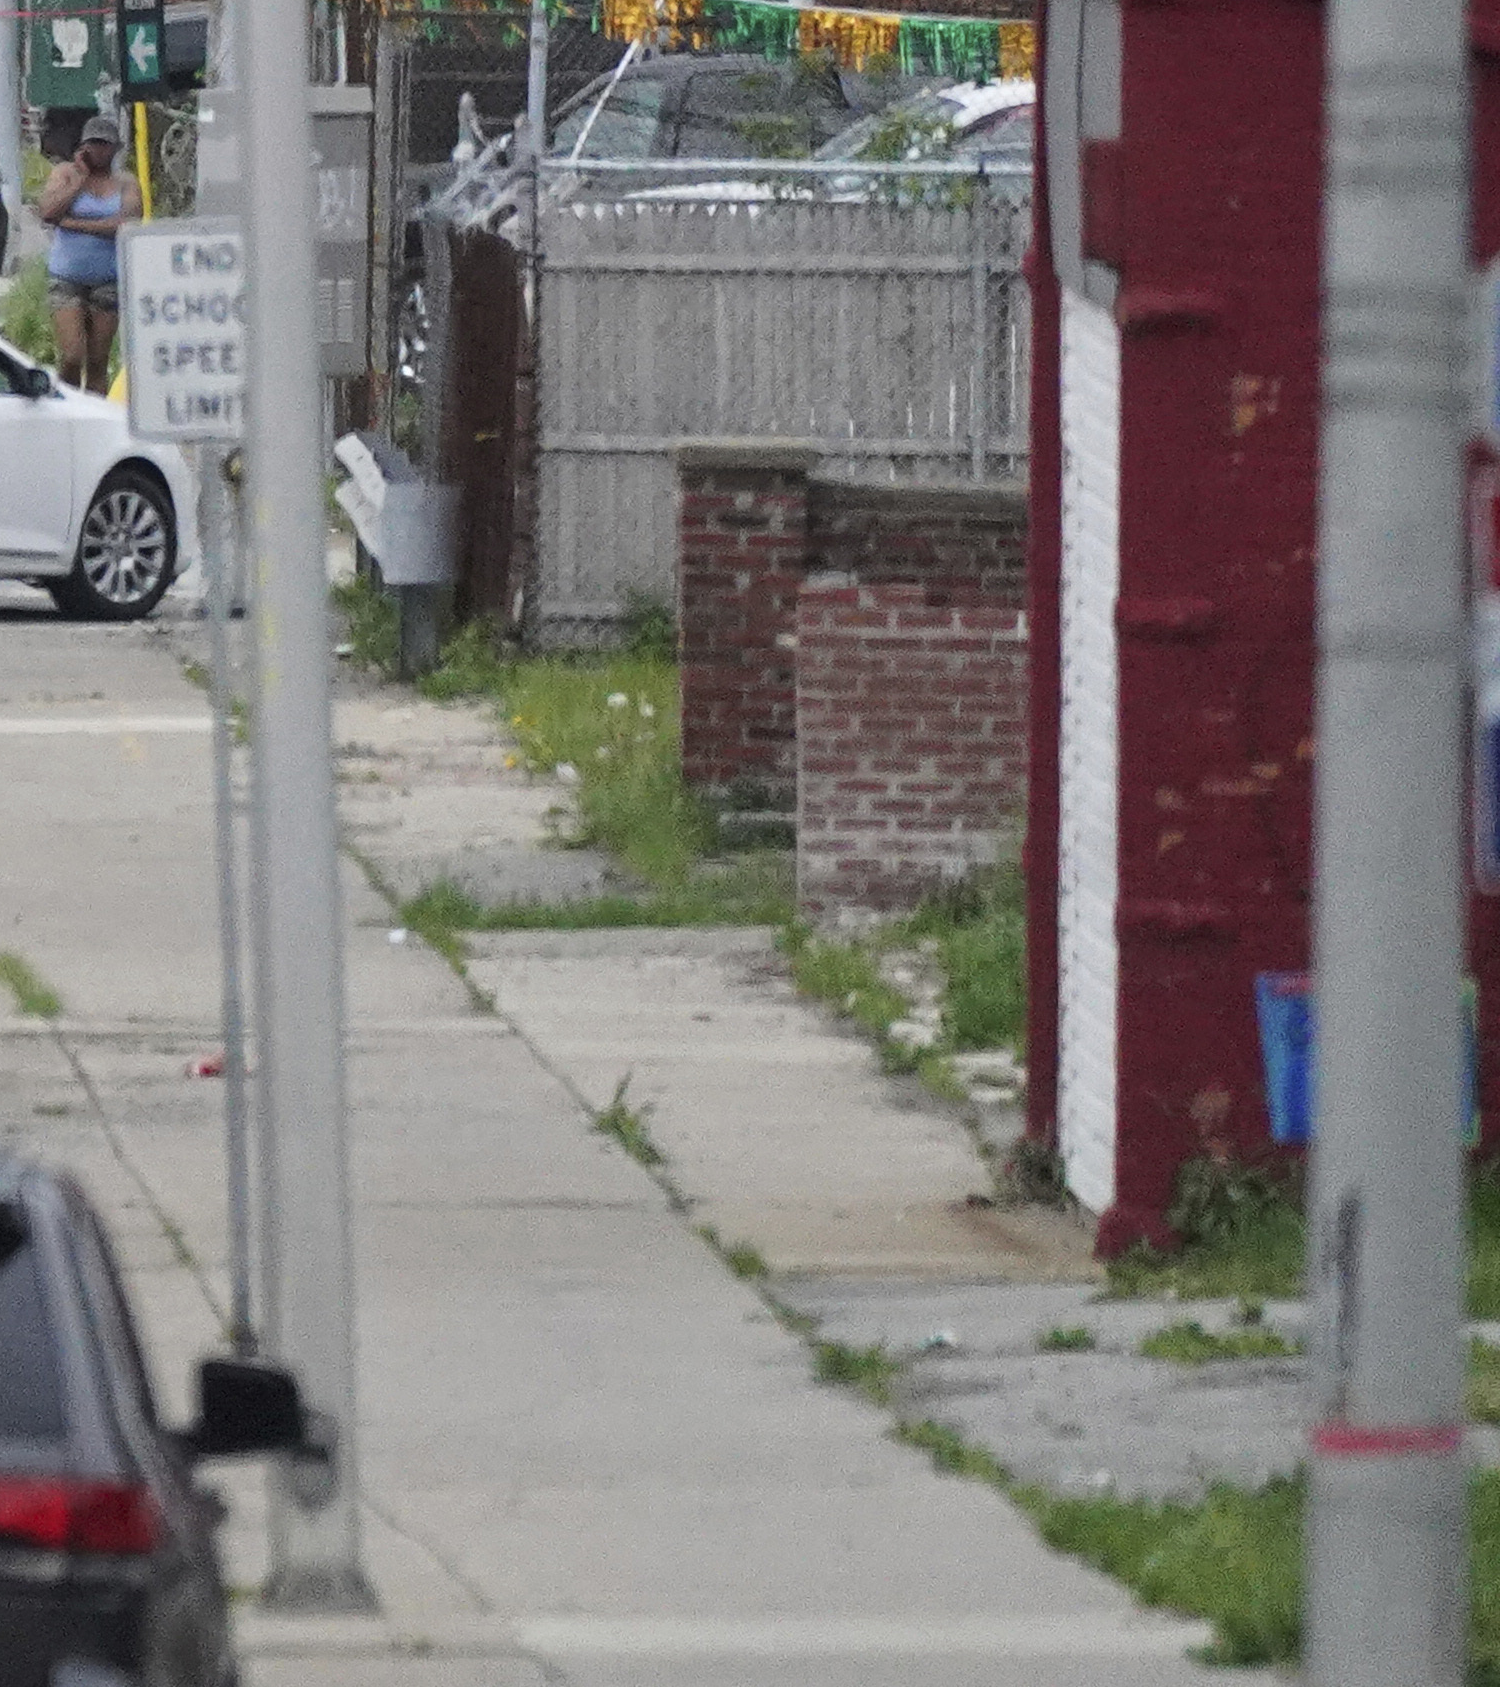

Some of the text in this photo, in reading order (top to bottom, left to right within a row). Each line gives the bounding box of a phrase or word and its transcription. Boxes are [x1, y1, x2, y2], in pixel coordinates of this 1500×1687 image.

[170, 242, 235, 275] END
[153, 339, 239, 375] SPEE
[166, 392, 235, 425] LIMI
